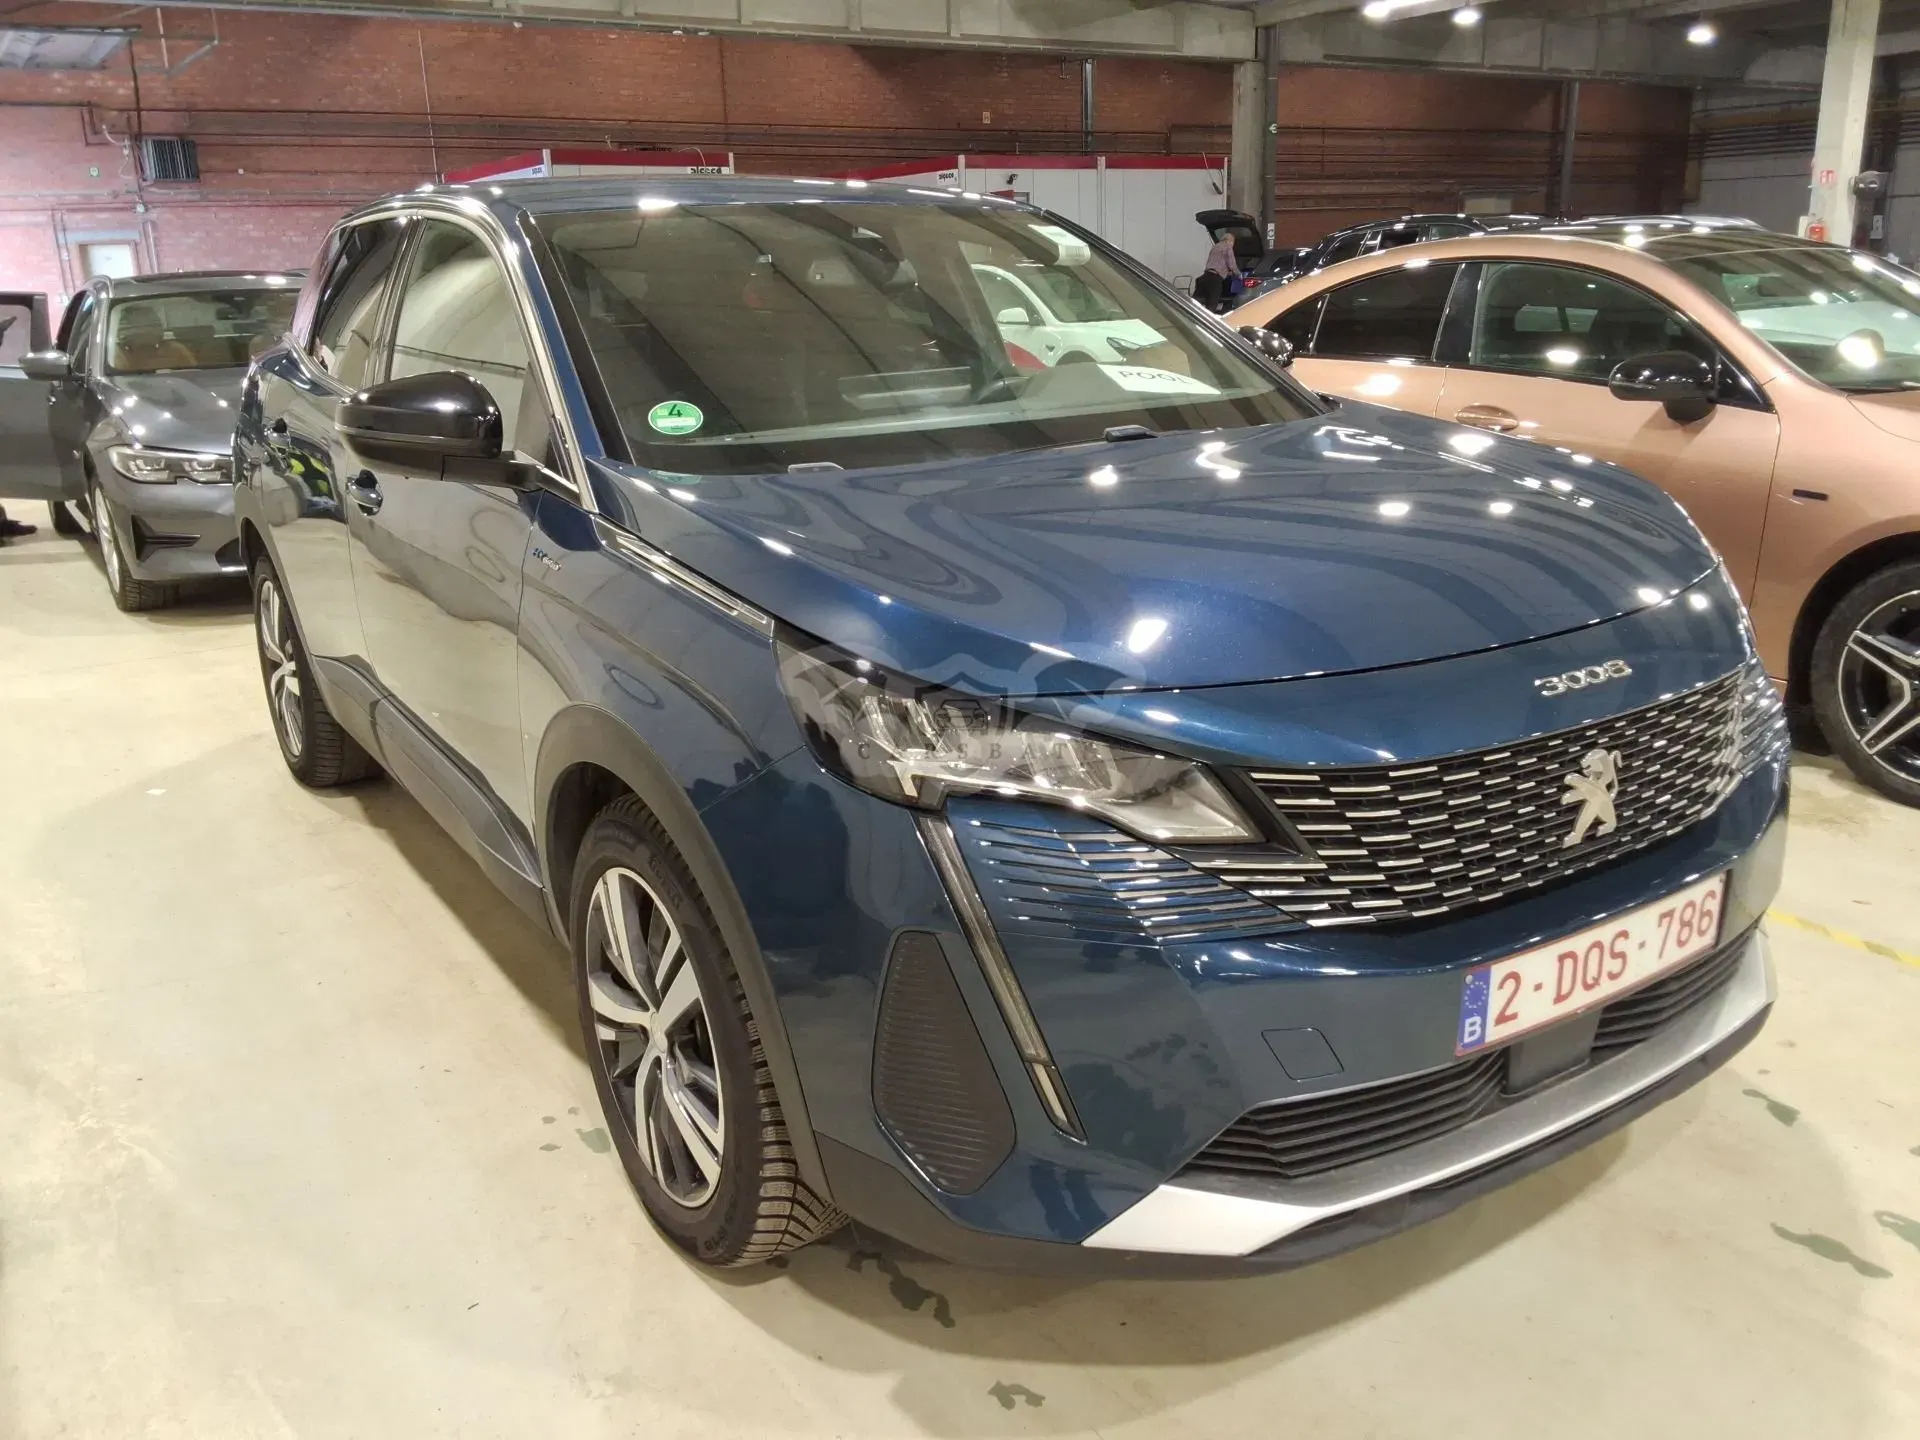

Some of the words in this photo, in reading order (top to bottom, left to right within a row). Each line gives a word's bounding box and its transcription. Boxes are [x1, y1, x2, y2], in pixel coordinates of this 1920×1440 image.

[1118, 370, 1193, 384] POOL
[668, 403, 684, 418] 4
[1534, 659, 1632, 696] 3008
[1493, 889, 1717, 1027] 2-DQS-786
[1463, 1015, 1482, 1044] B
